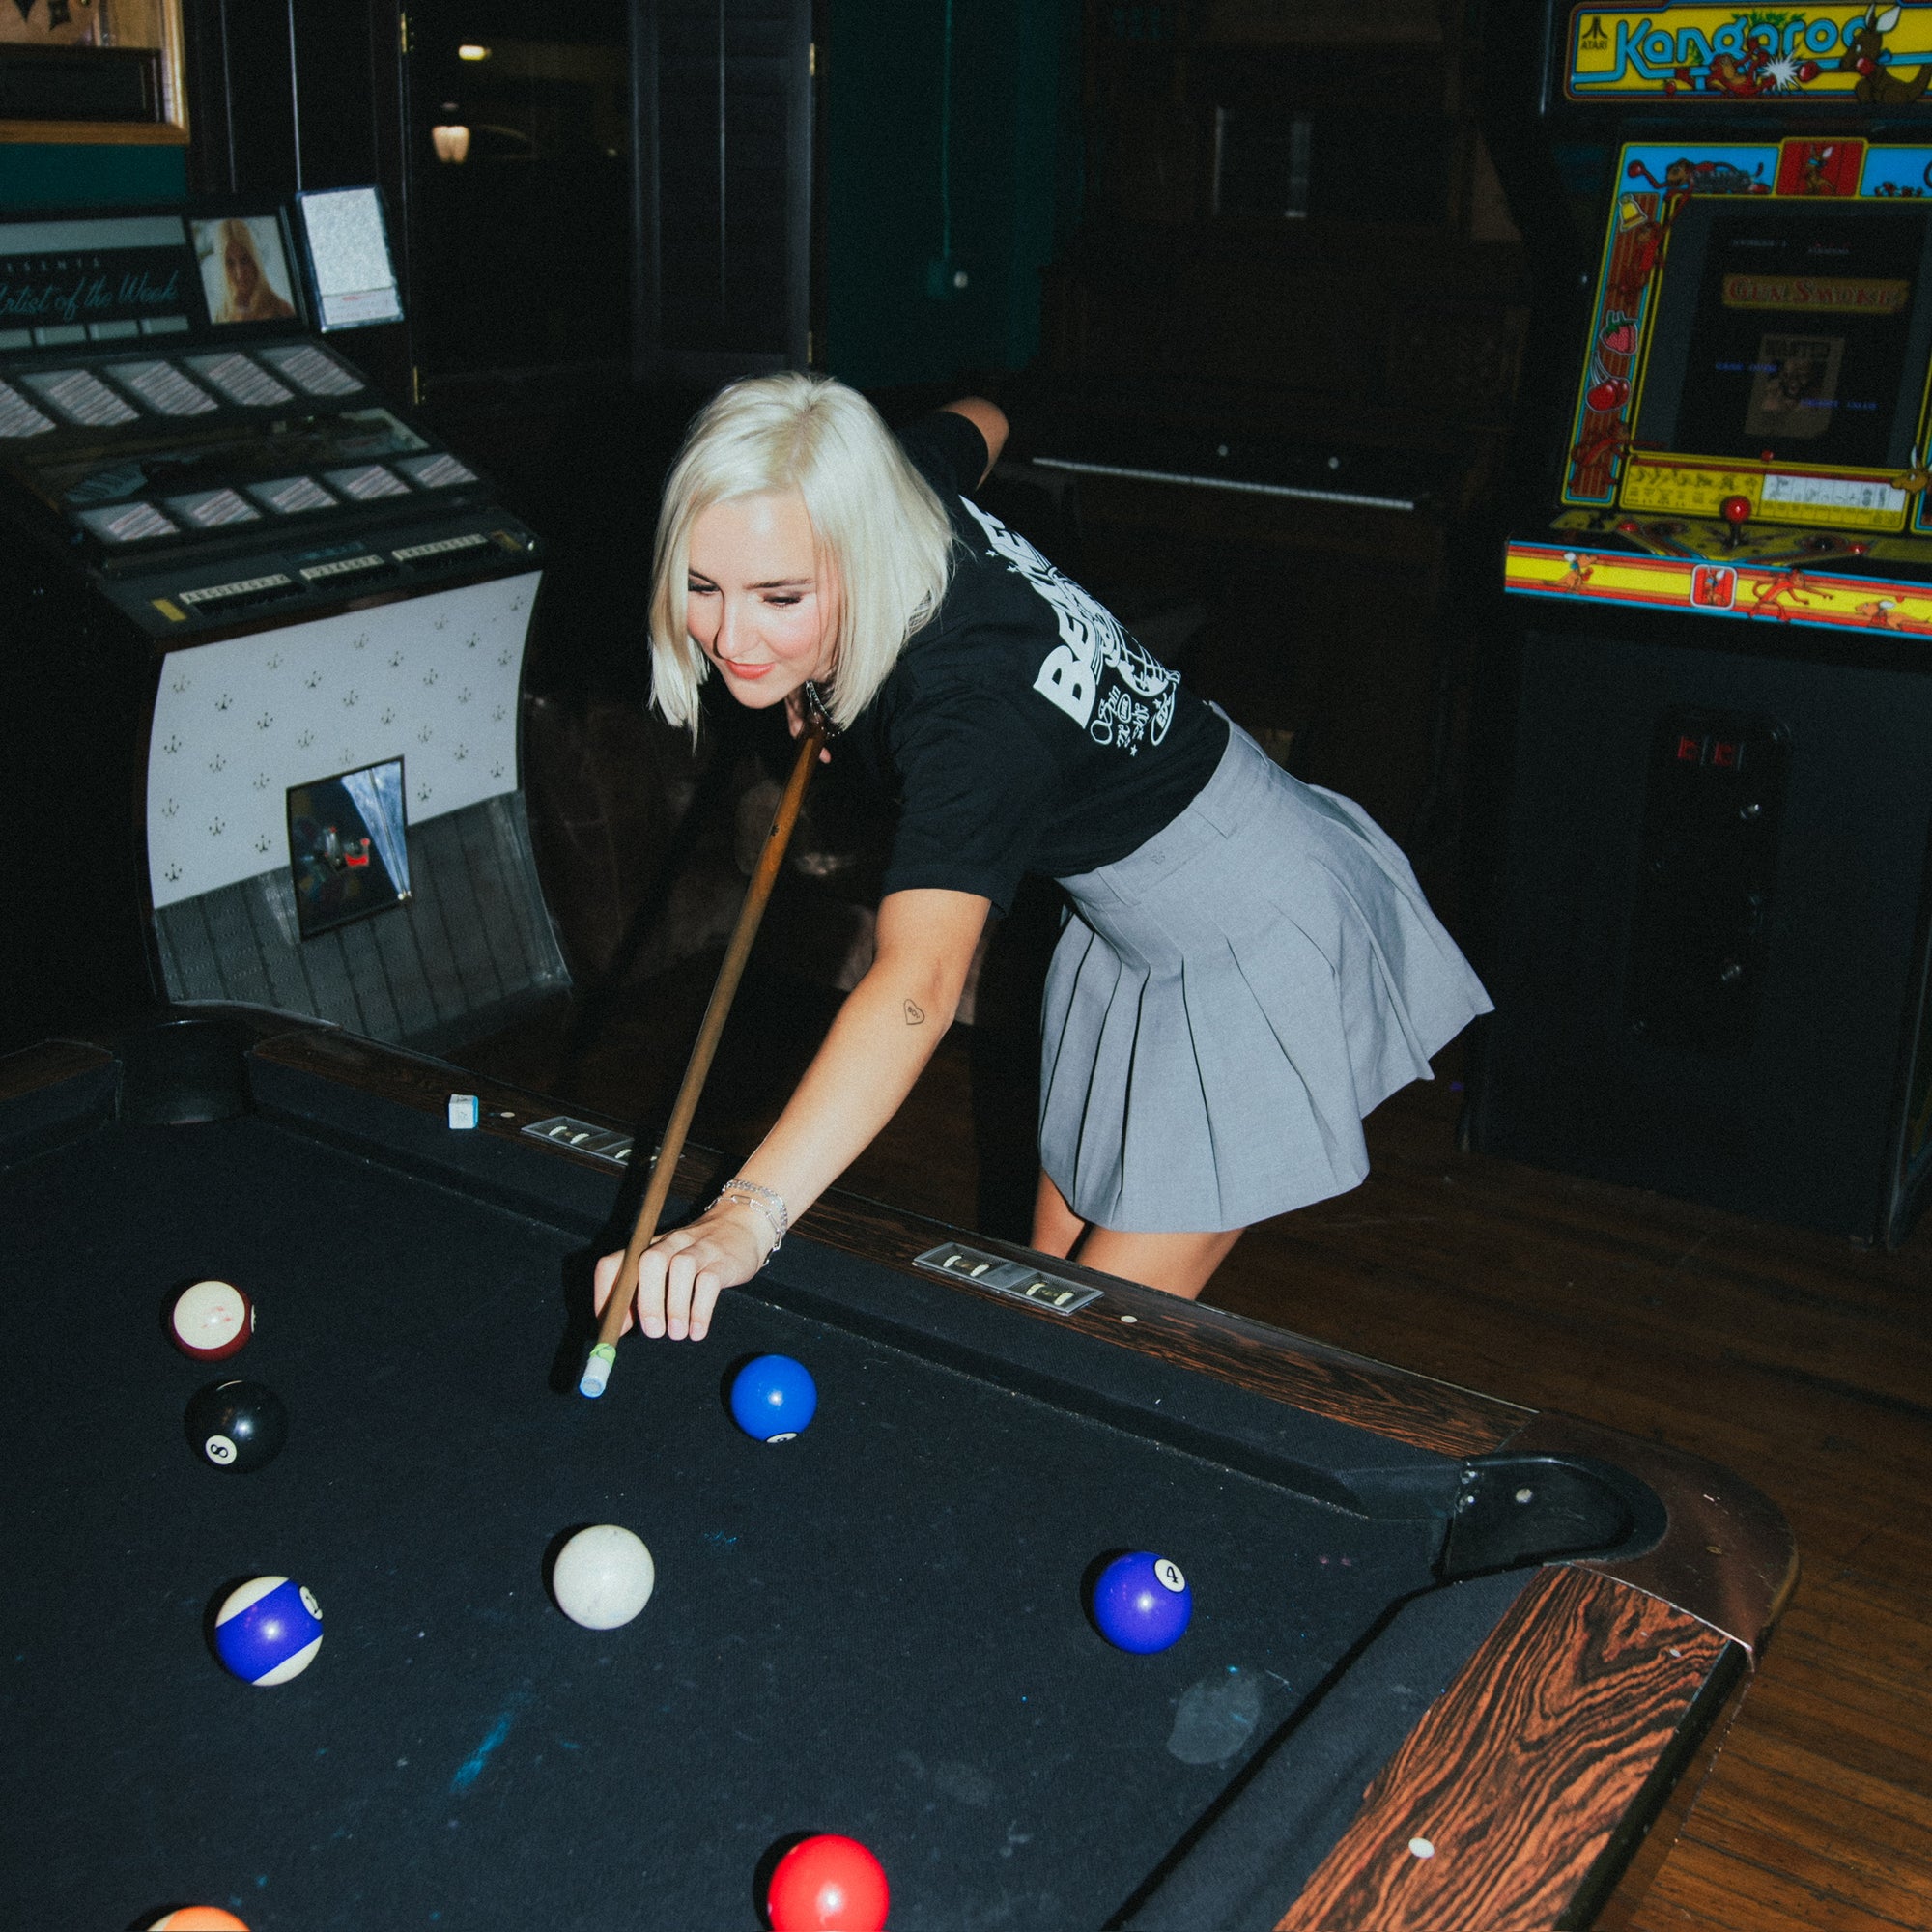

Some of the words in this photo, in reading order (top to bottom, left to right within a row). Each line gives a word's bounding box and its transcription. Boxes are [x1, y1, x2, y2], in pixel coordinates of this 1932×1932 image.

[1581, 41, 1607, 50] ATARI
[211, 1444, 228, 1458] 8
[1166, 1565, 1179, 1584] 4
